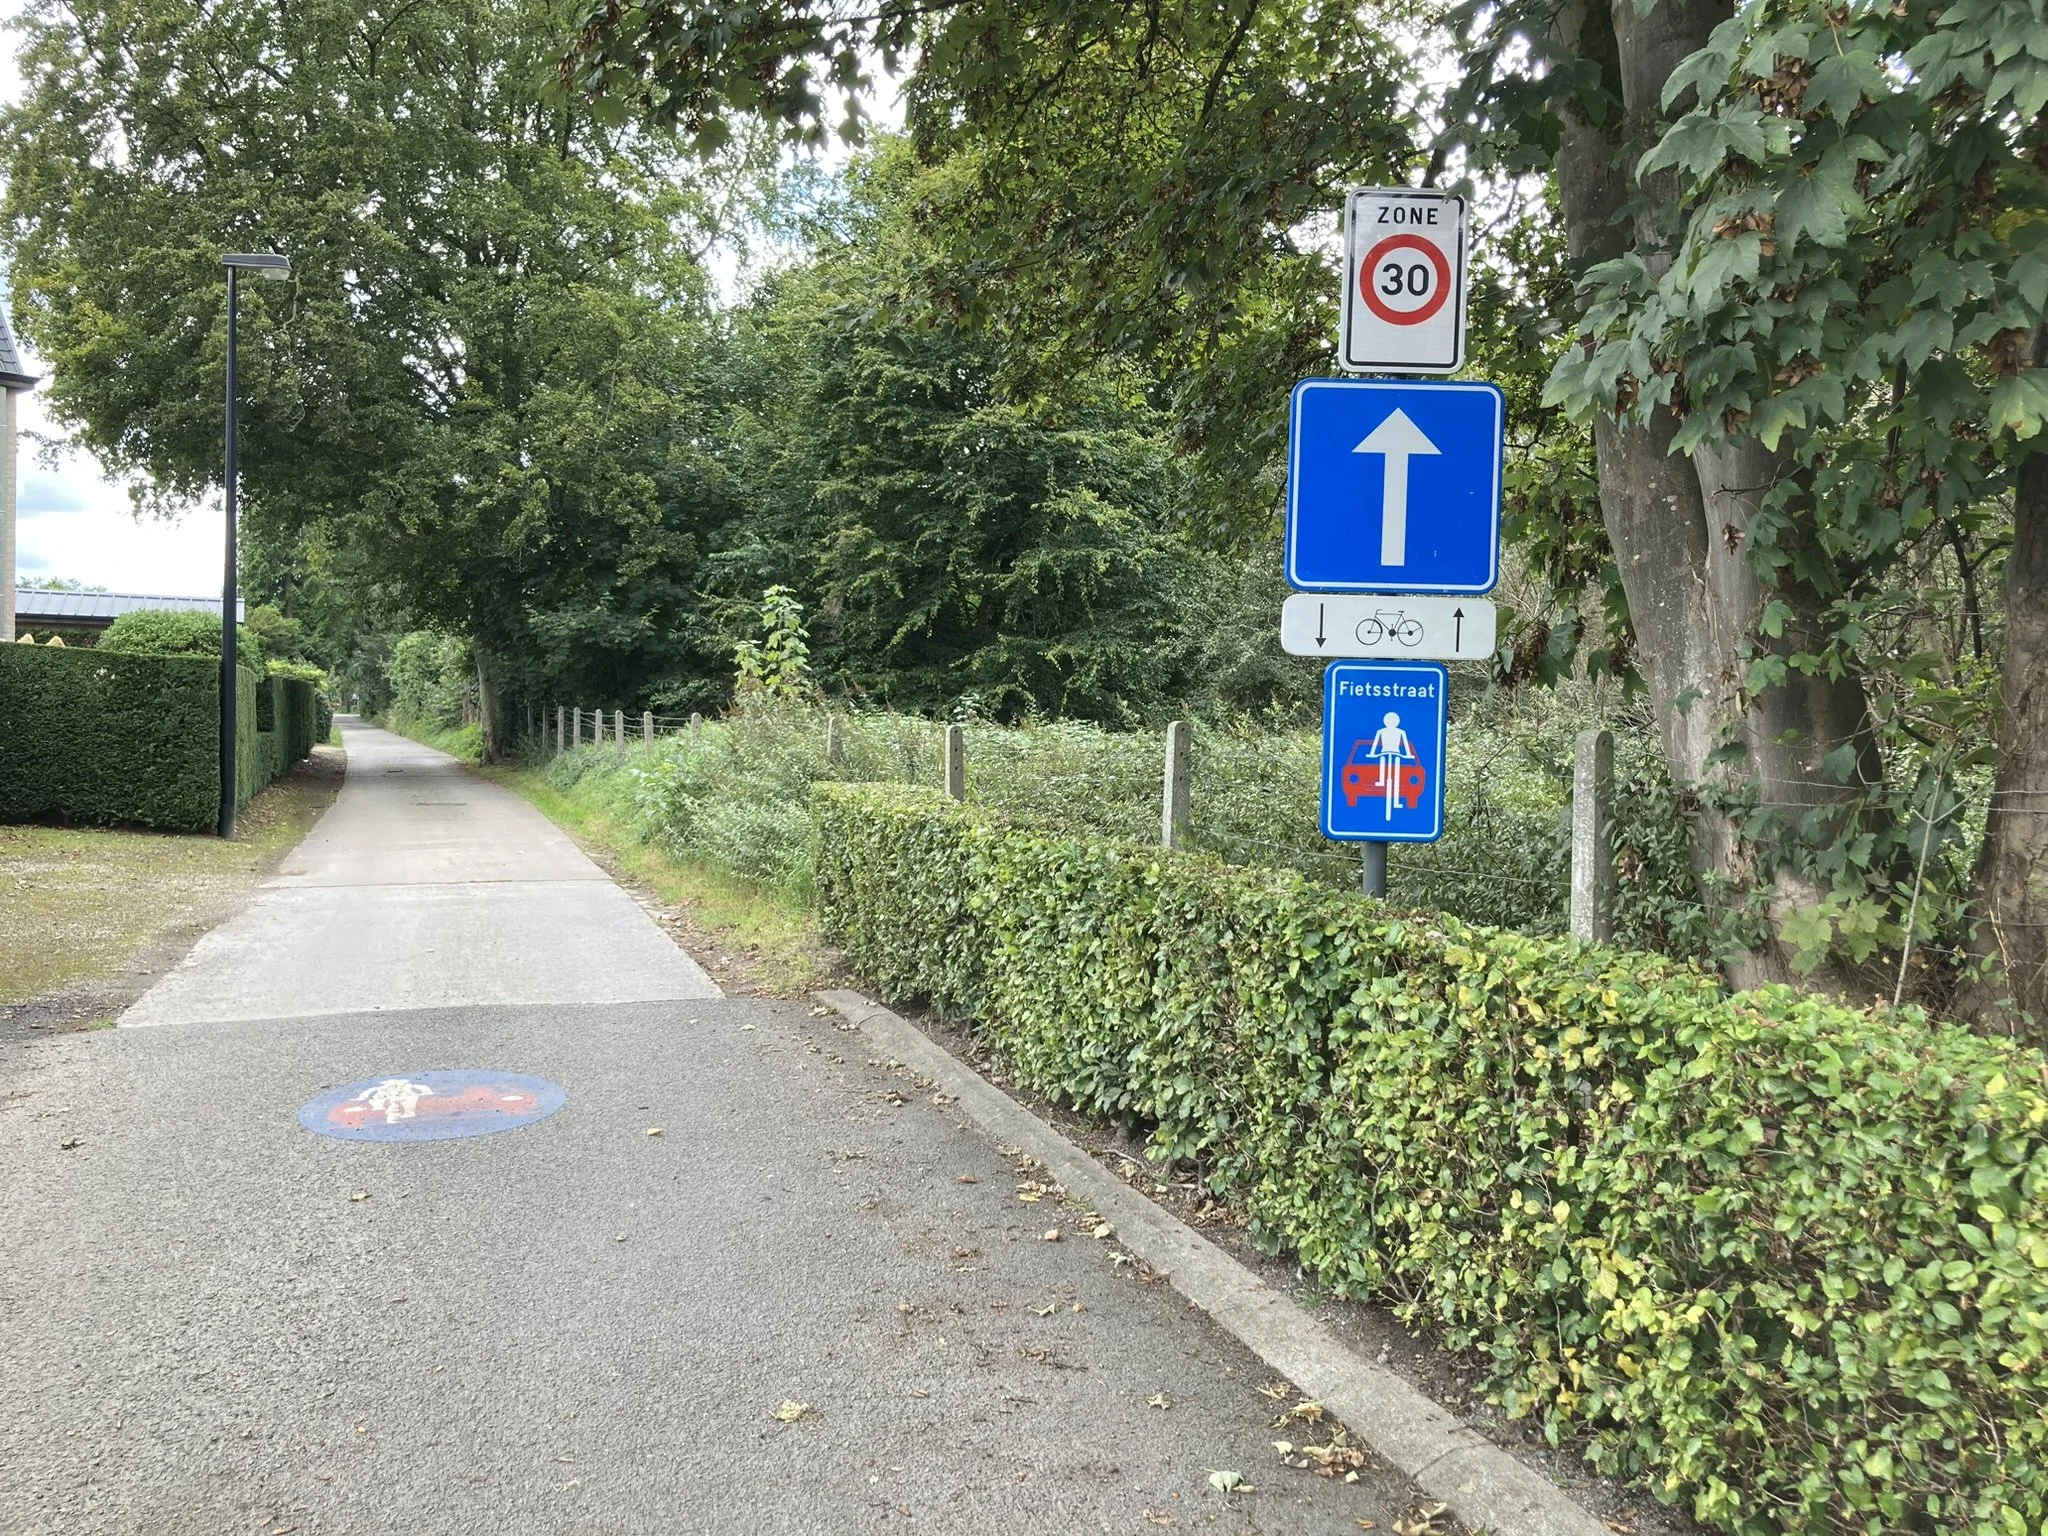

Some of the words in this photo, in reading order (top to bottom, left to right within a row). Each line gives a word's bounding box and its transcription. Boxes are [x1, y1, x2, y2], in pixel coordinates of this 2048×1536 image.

[1377, 206, 1439, 225] ZONE
[1381, 263, 1430, 297] 30
[1339, 681, 1435, 698] Fietsstraat
